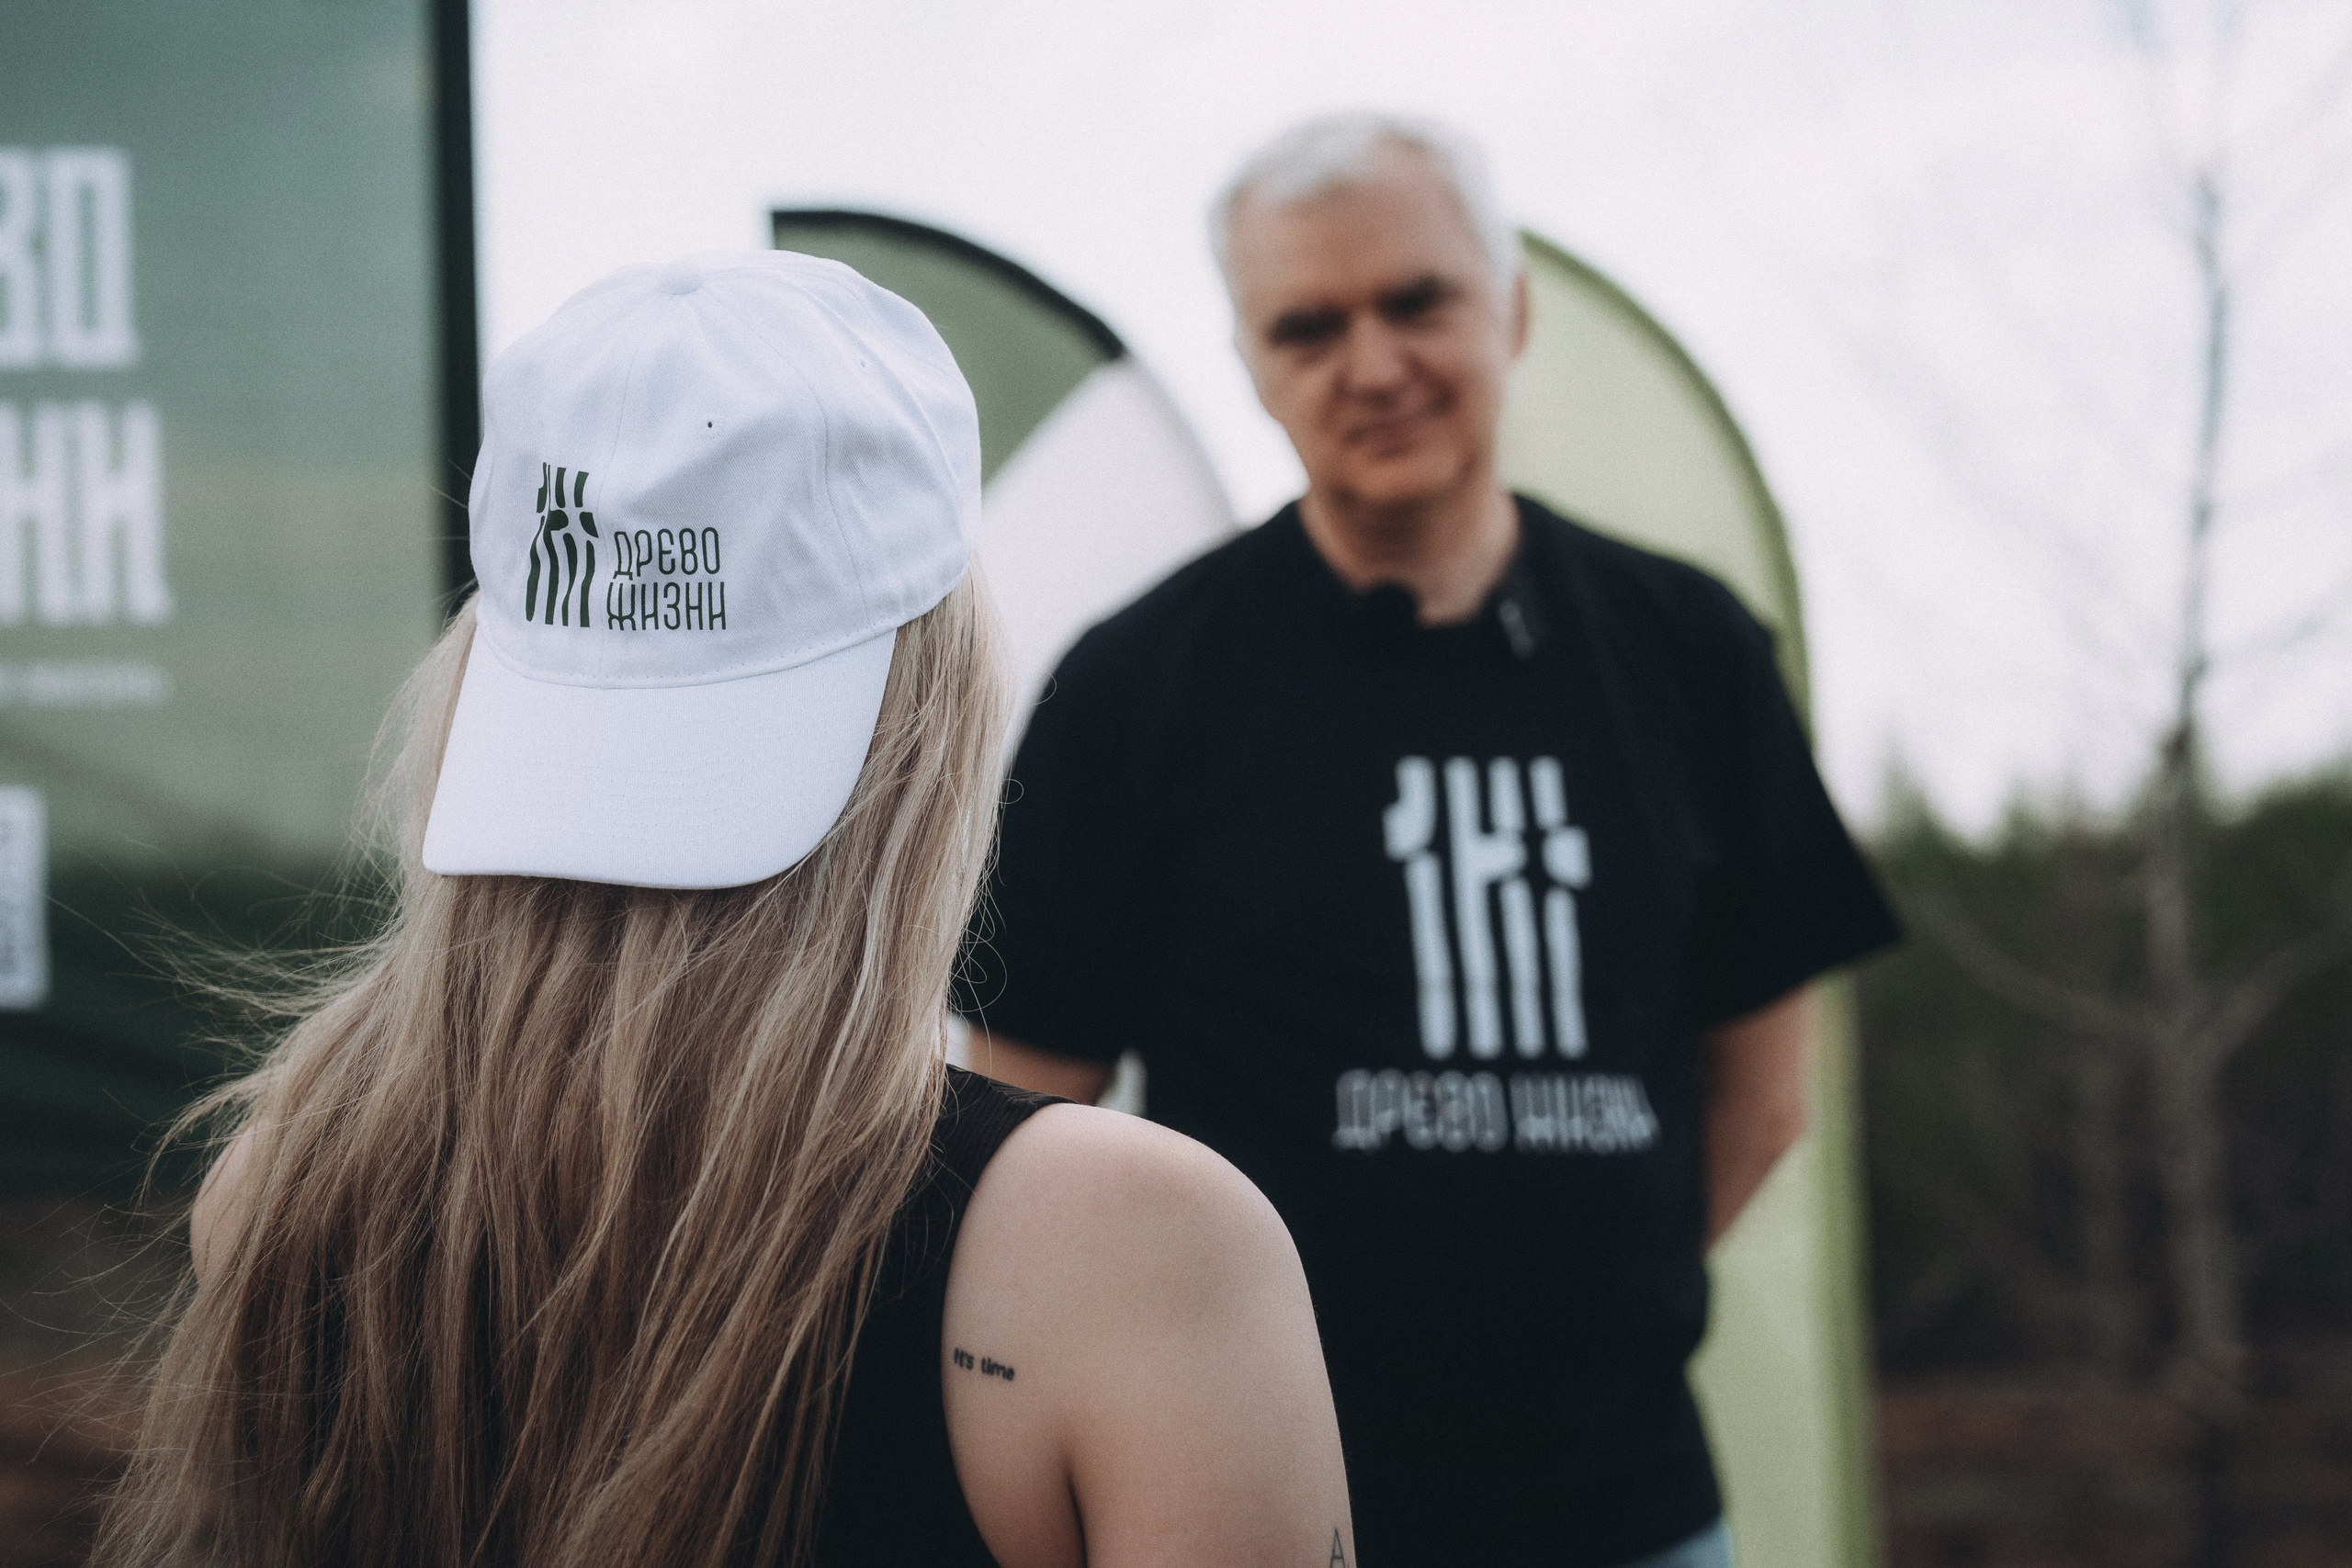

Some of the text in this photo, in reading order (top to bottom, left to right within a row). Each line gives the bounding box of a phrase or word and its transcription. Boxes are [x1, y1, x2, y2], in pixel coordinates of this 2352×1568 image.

[613, 526, 720, 581] ДРЕВО
[606, 581, 727, 631] ЖИЗНИ
[1331, 1068, 1509, 1153] ДРЕВО
[980, 1357, 1015, 1382] time
